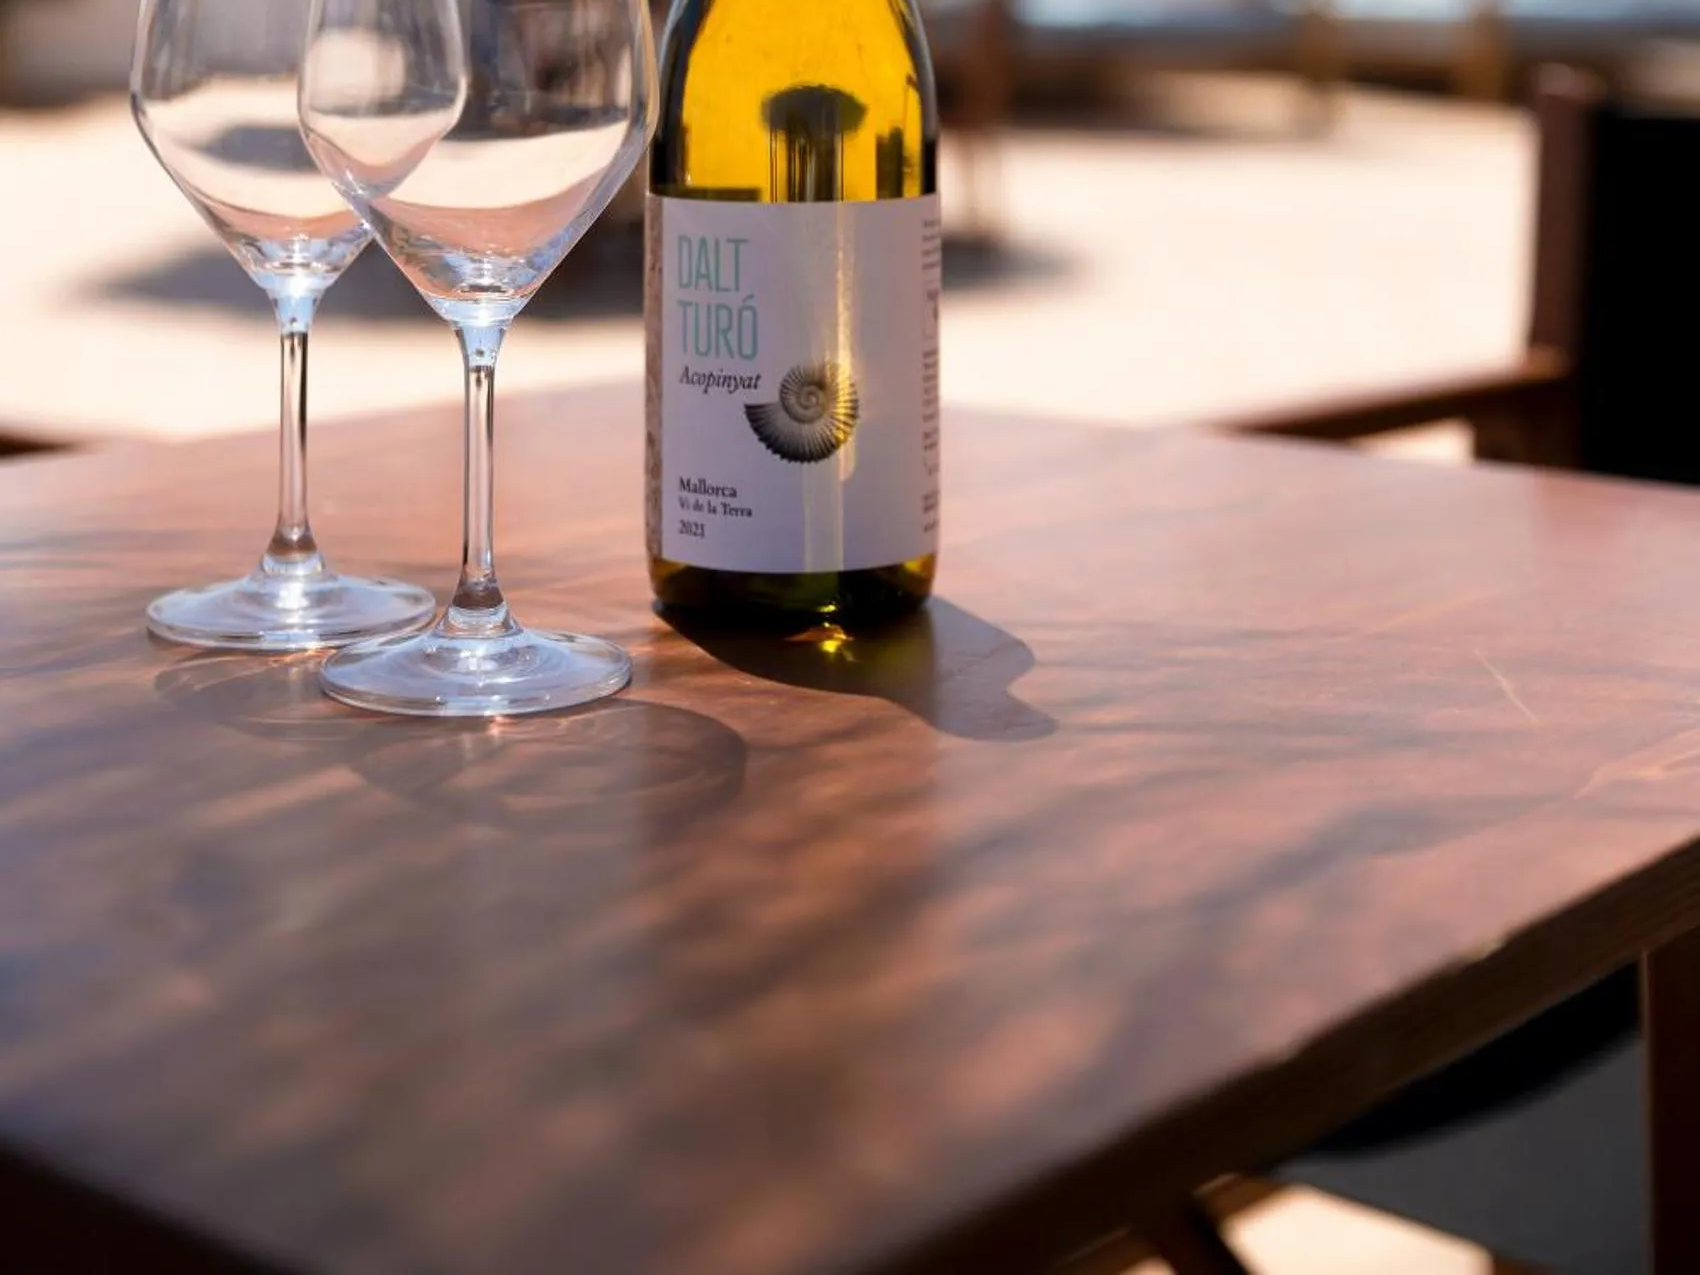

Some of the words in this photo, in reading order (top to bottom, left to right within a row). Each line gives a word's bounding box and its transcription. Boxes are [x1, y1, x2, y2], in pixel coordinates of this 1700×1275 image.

[677, 234, 750, 293] DALT
[676, 293, 759, 361] TURÓ
[679, 365, 762, 394] Acopinyat
[678, 476, 738, 498] Mallorca
[692, 498, 704, 512] de
[707, 499, 717, 514] la
[720, 501, 753, 517] Terra
[678, 519, 706, 538] 2021
